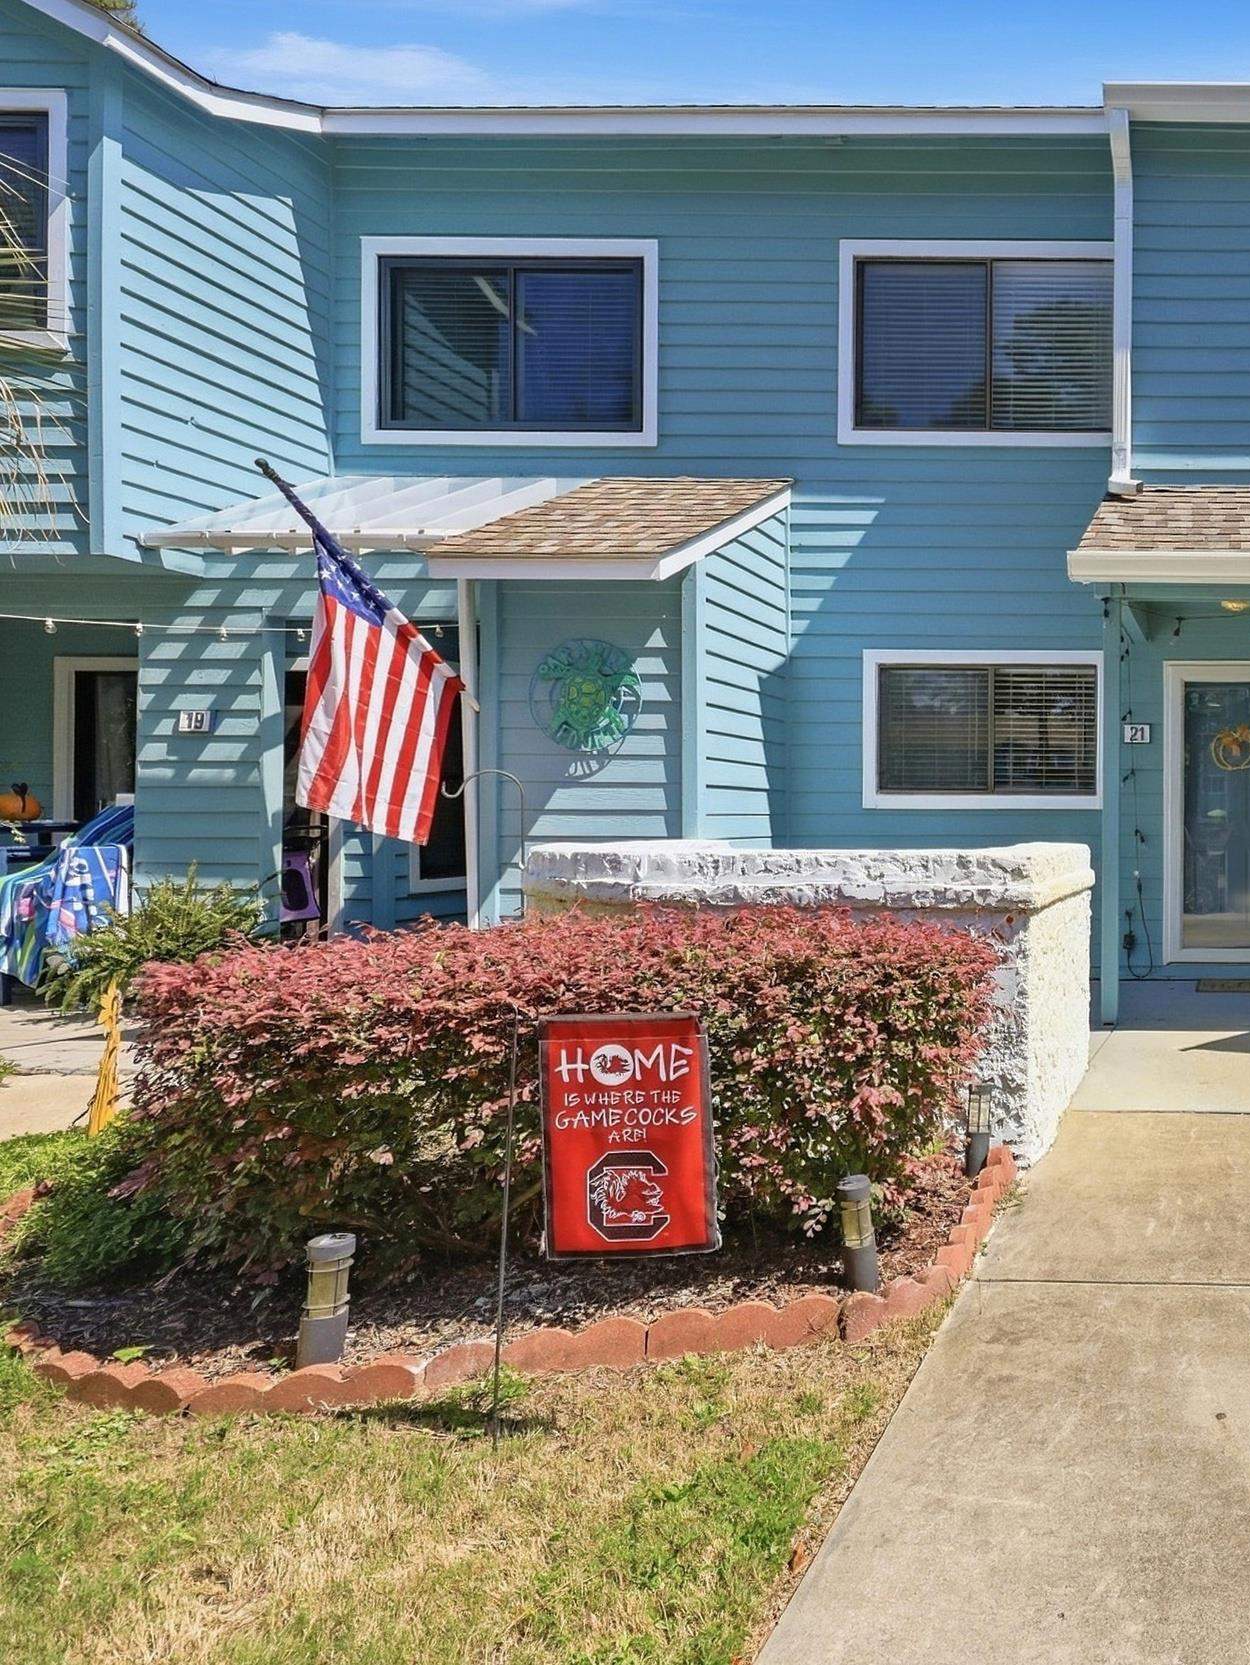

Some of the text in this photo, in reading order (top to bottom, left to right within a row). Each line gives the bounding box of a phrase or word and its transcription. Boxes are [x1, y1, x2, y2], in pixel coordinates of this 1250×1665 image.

[187, 712, 204, 729] 19
[1129, 726, 1145, 741] 21
[555, 1044, 693, 1086] HOME
[564, 1090, 681, 1107] IS WHERE THE
[555, 1107, 697, 1129] GAMECOCKS
